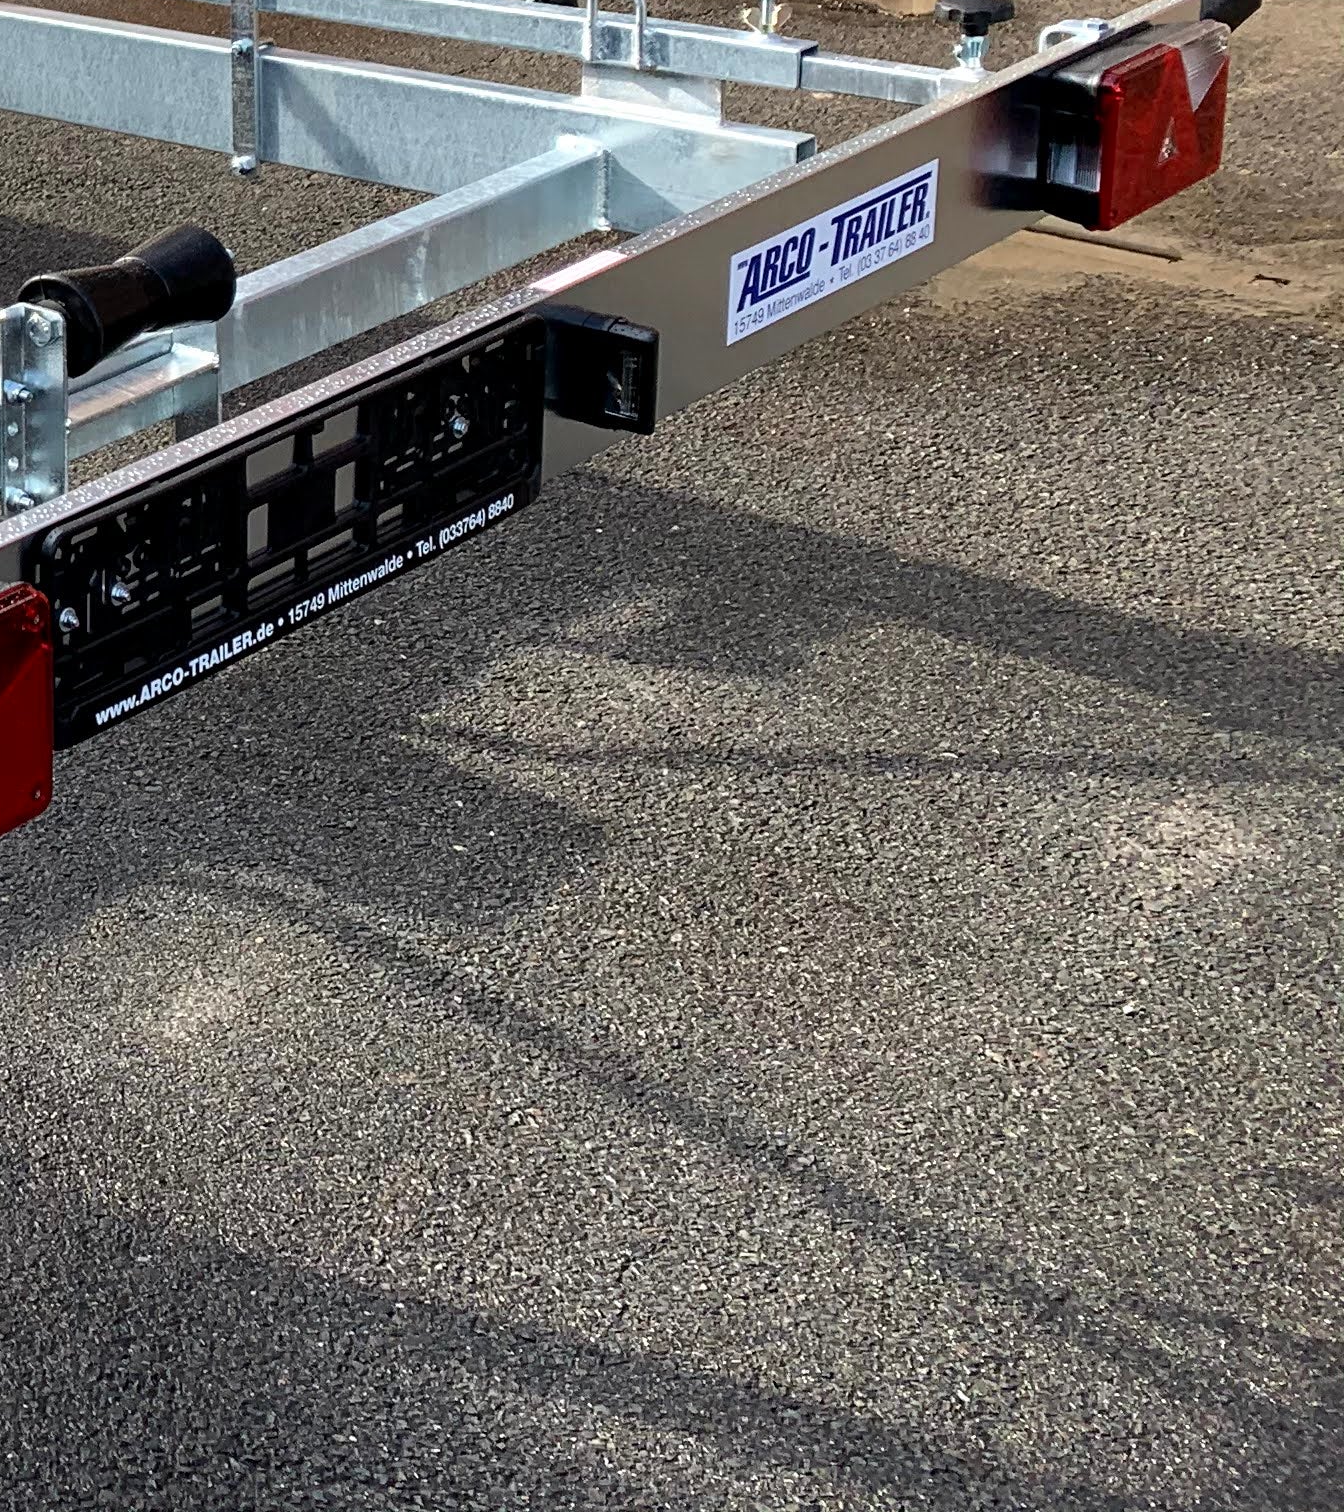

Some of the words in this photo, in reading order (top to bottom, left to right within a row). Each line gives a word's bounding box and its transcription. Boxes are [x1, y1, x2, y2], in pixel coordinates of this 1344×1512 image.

[733, 307, 765, 336] 15749
[766, 278, 826, 320] Mittenwalde
[838, 262, 853, 283] Tel.
[918, 221, 931, 241] 40
[95, 622, 274, 726] www.ARCO-TRAILER.de
[288, 593, 325, 624] 15749
[328, 555, 404, 605] Mittenwalde
[415, 536, 437, 558] Tel.
[439, 508, 486, 550] (033764)
[488, 493, 514, 520] 8840
